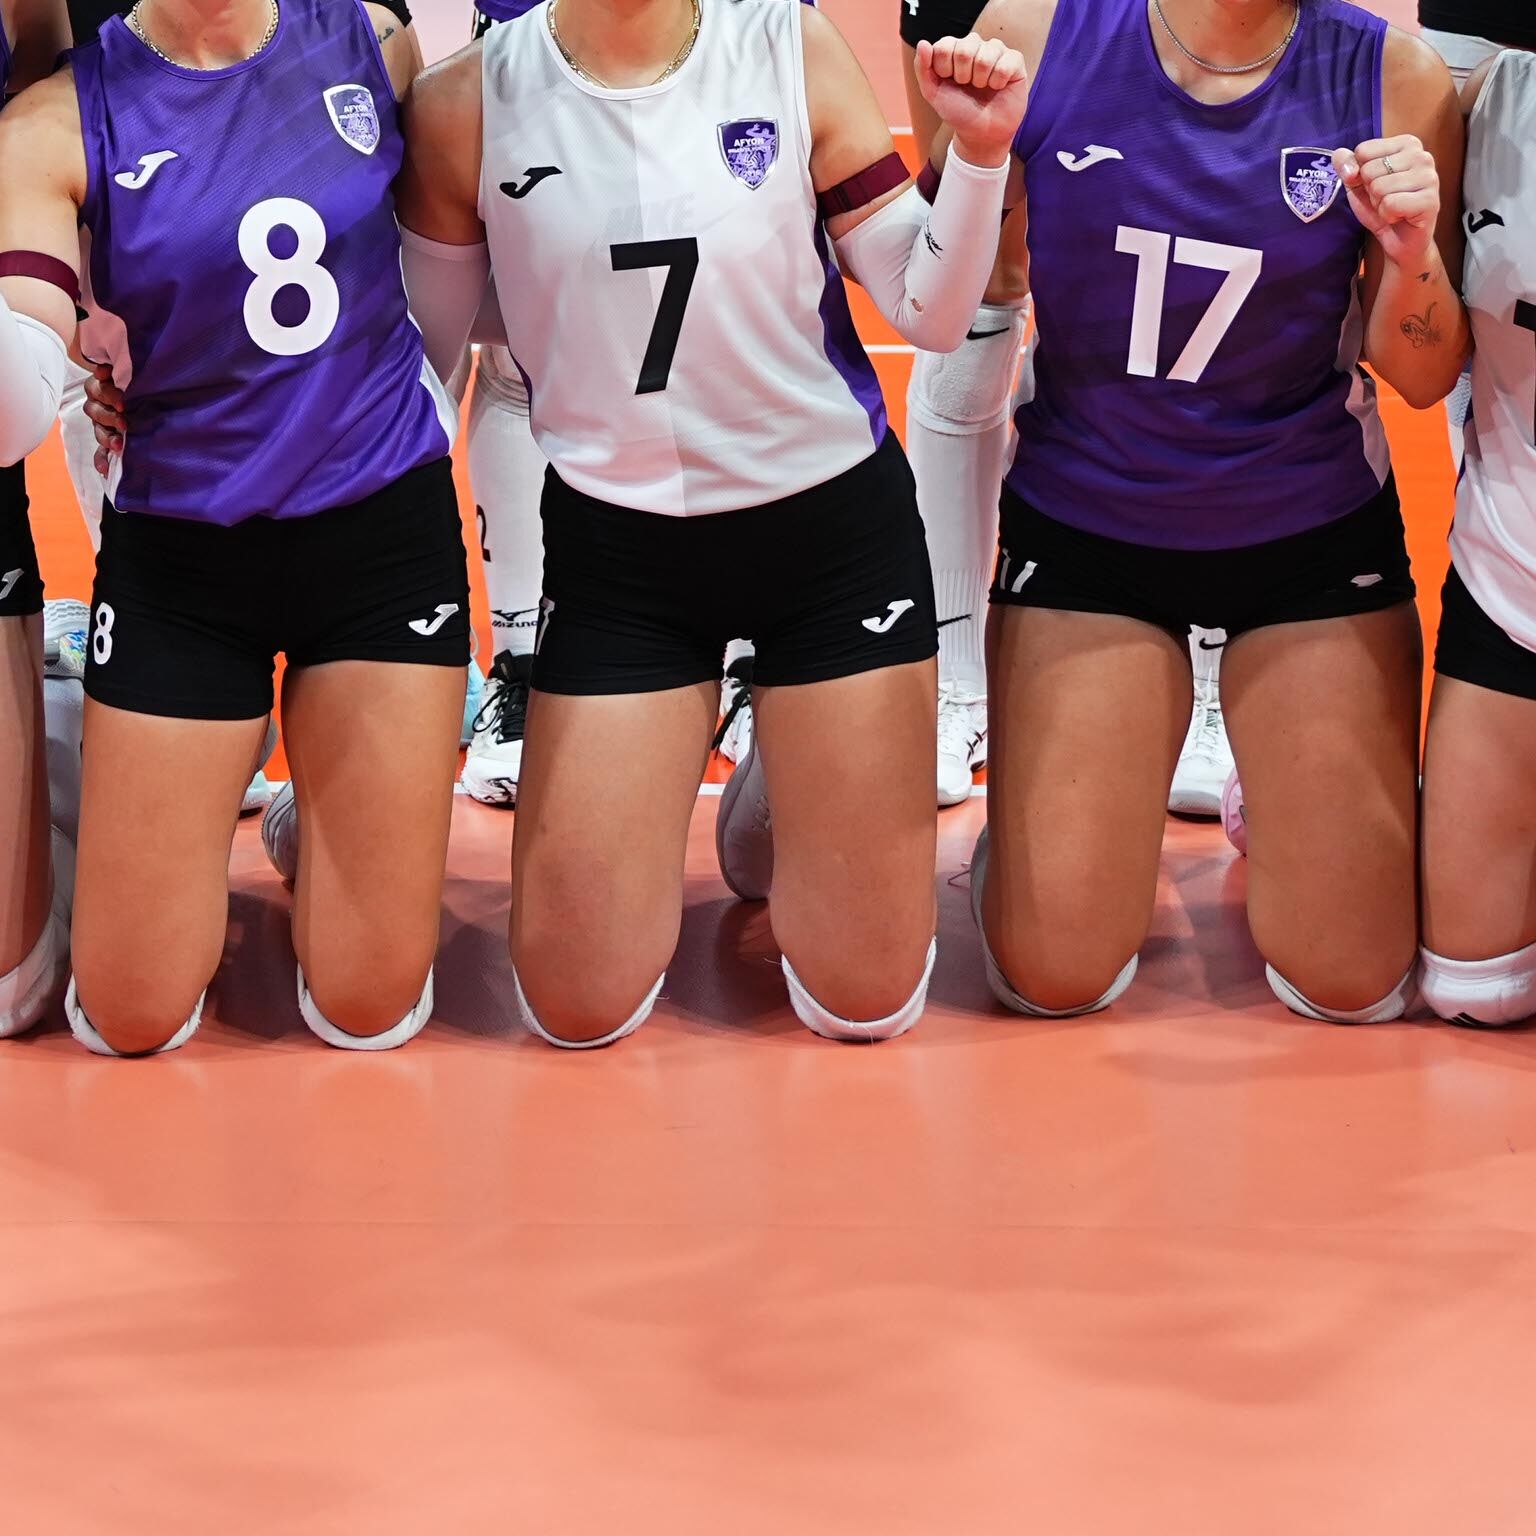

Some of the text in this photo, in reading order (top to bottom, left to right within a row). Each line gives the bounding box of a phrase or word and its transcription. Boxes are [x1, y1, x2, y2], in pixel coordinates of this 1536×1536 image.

[733, 137, 765, 148] AFYON
[1295, 168, 1329, 179] AFYON
[237, 197, 341, 357] 8
[609, 236, 700, 396] 7
[1114, 225, 1263, 384] 17
[92, 601, 116, 666] 8
